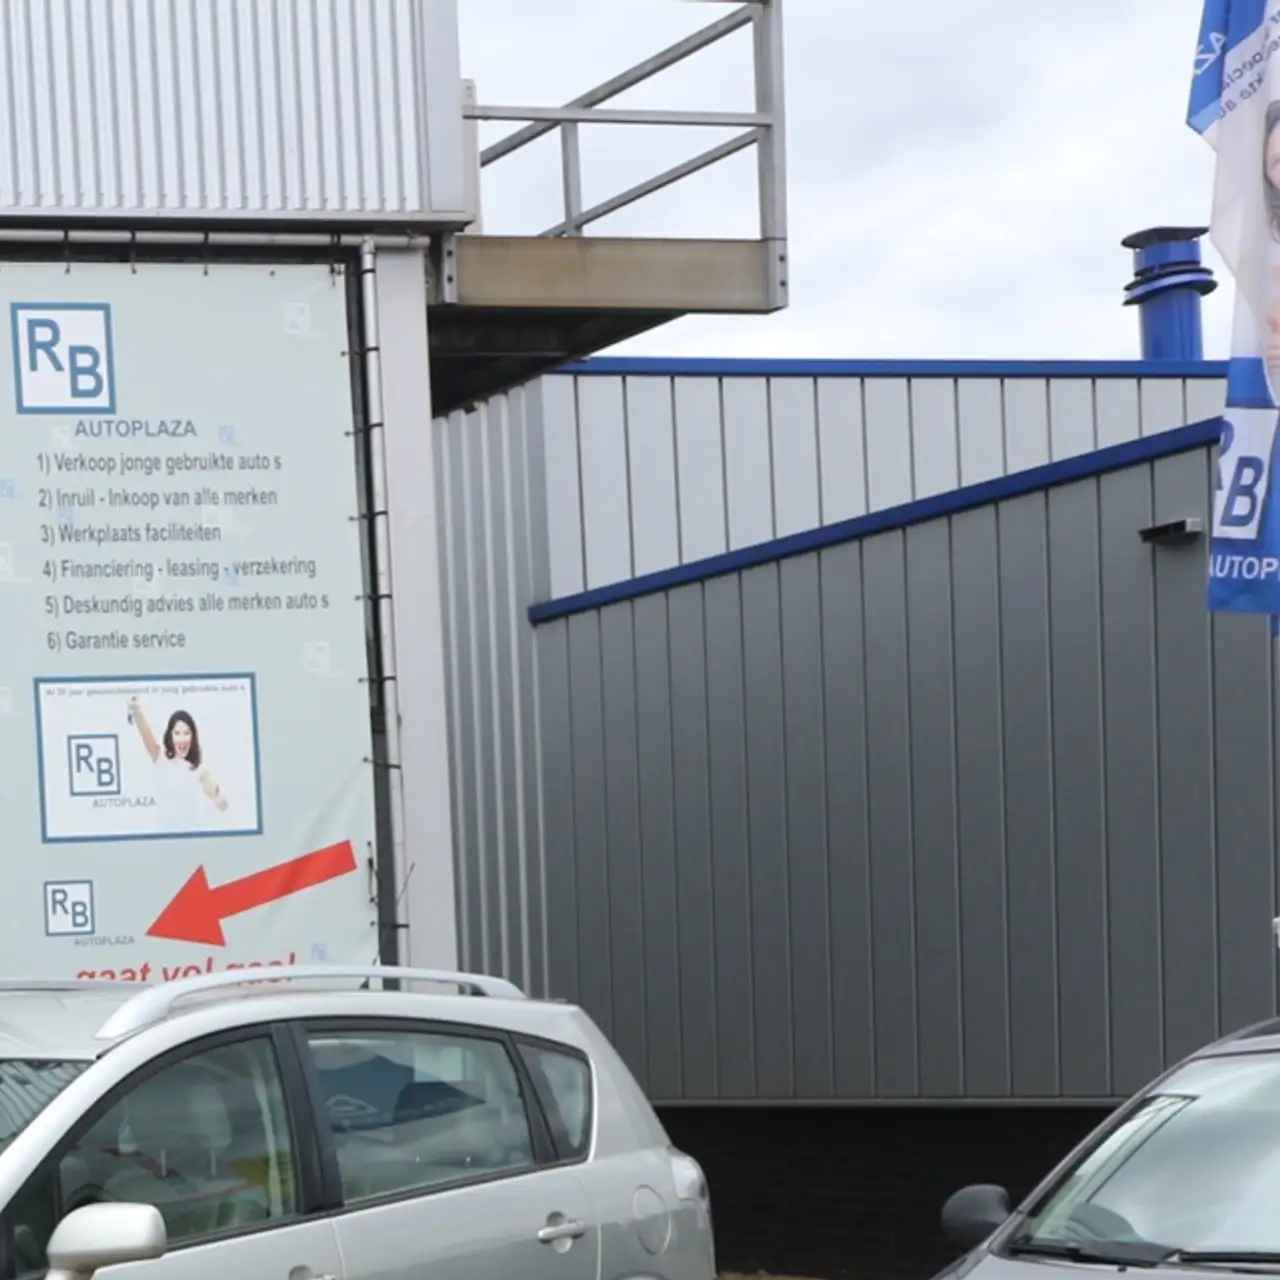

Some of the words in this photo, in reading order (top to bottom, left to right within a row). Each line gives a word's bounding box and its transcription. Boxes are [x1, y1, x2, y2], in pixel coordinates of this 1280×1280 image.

[26, 318, 105, 398] RB
[74, 421, 198, 437] AUTOPLAZA
[37, 453, 51, 477] 1)
[54, 452, 117, 476] Verkoop
[120, 452, 162, 475] jonge
[166, 453, 234, 475] gebruikte
[238, 455, 269, 470] auto
[38, 489, 53, 511] 2)
[56, 490, 95, 507] Inruil
[109, 490, 160, 510] Inkoop
[163, 493, 190, 506] van
[194, 488, 219, 506] alle
[224, 489, 278, 506] merken
[40, 524, 55, 547] 3)
[59, 524, 141, 547] Werkplaats
[145, 523, 222, 542] faciliteiten
[42, 561, 57, 583] 4)
[61, 559, 154, 581] Financiering
[166, 558, 220, 580] leasing
[232, 556, 317, 579] verzekering
[45, 597, 59, 619] 5)
[63, 595, 143, 618] Deskundig
[147, 594, 195, 612] advies
[198, 593, 224, 611] alle
[228, 593, 281, 610] merken
[285, 593, 317, 610] auto
[47, 631, 61, 651] 6)
[65, 630, 129, 650] Garantie
[133, 629, 186, 648] service
[75, 743, 115, 787] RB
[93, 796, 156, 808] AUTOPLAZA
[51, 888, 89, 928] RB
